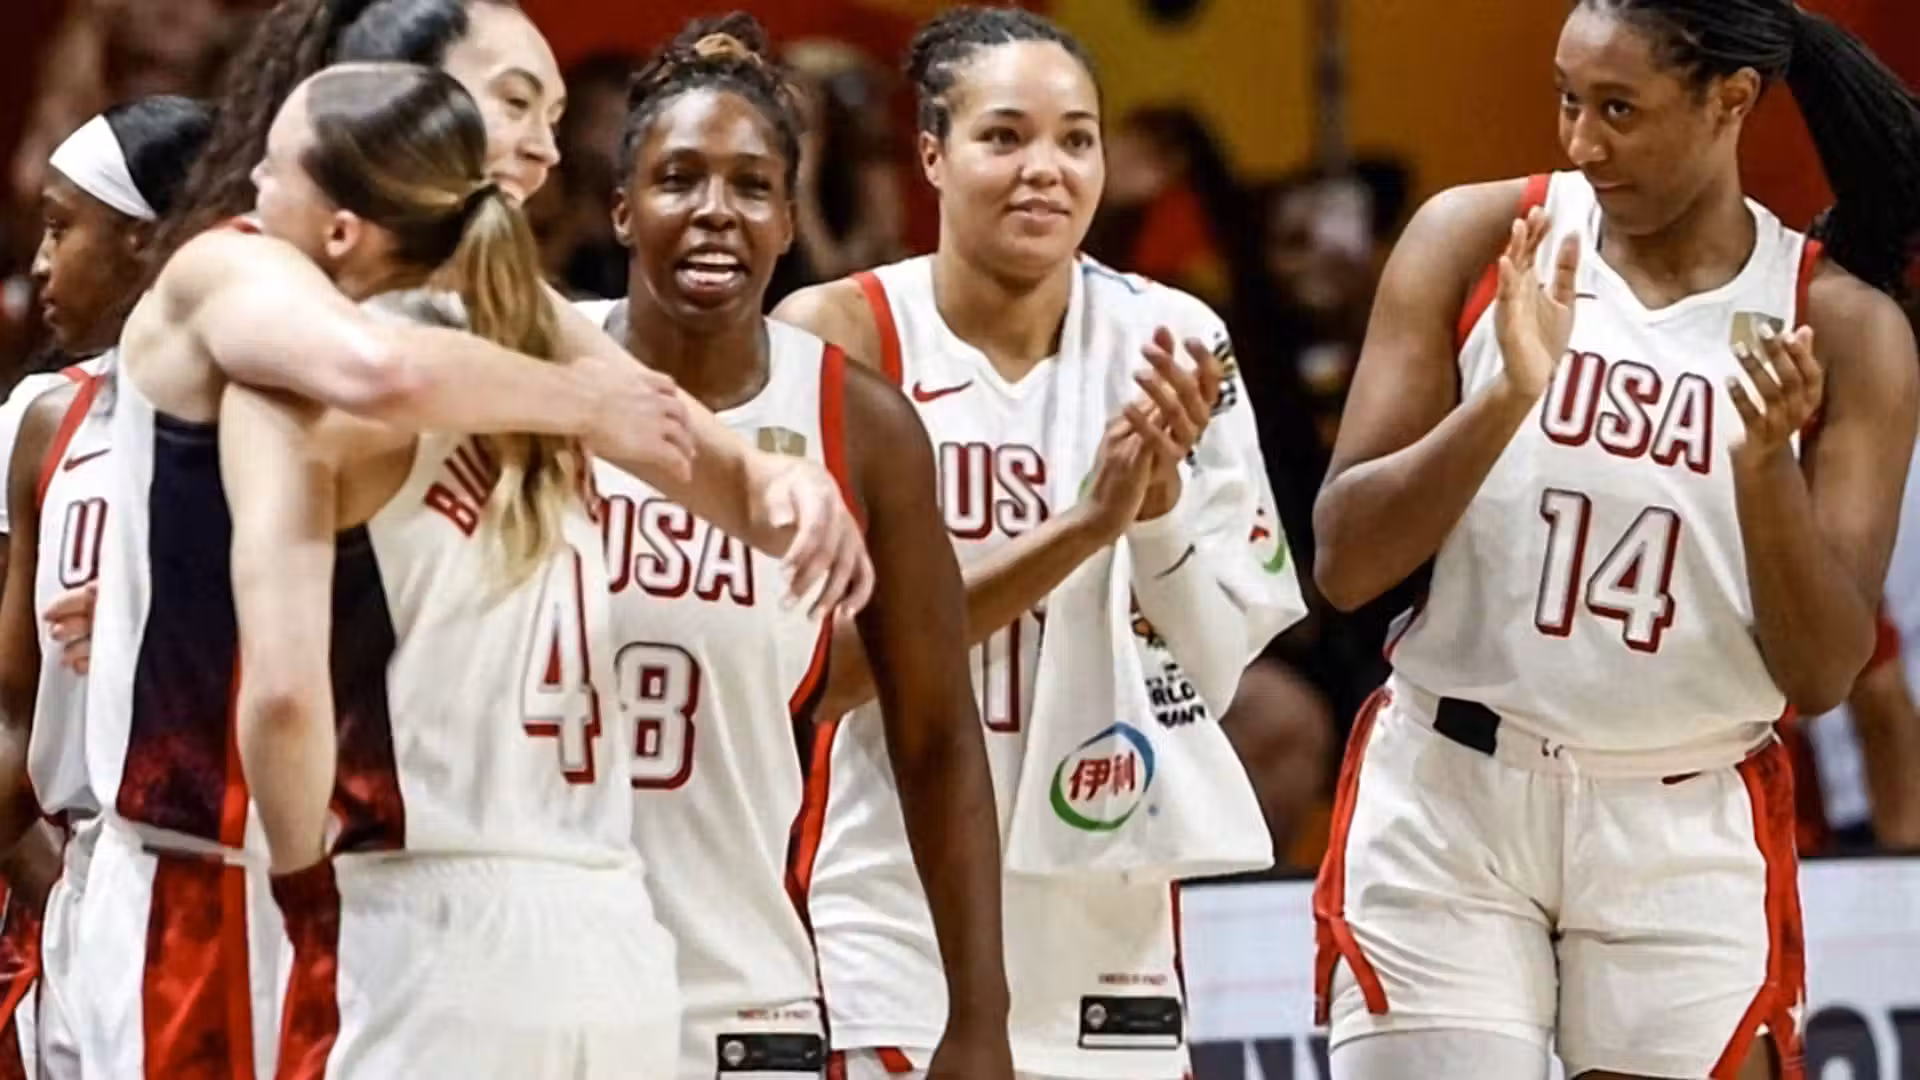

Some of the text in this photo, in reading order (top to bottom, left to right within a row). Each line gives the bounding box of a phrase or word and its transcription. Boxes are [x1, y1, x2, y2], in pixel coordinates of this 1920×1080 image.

[1540, 349, 1713, 474] USA
[1535, 487, 1681, 654] 14
[520, 550, 602, 784] 4
[613, 641, 701, 790] 8
